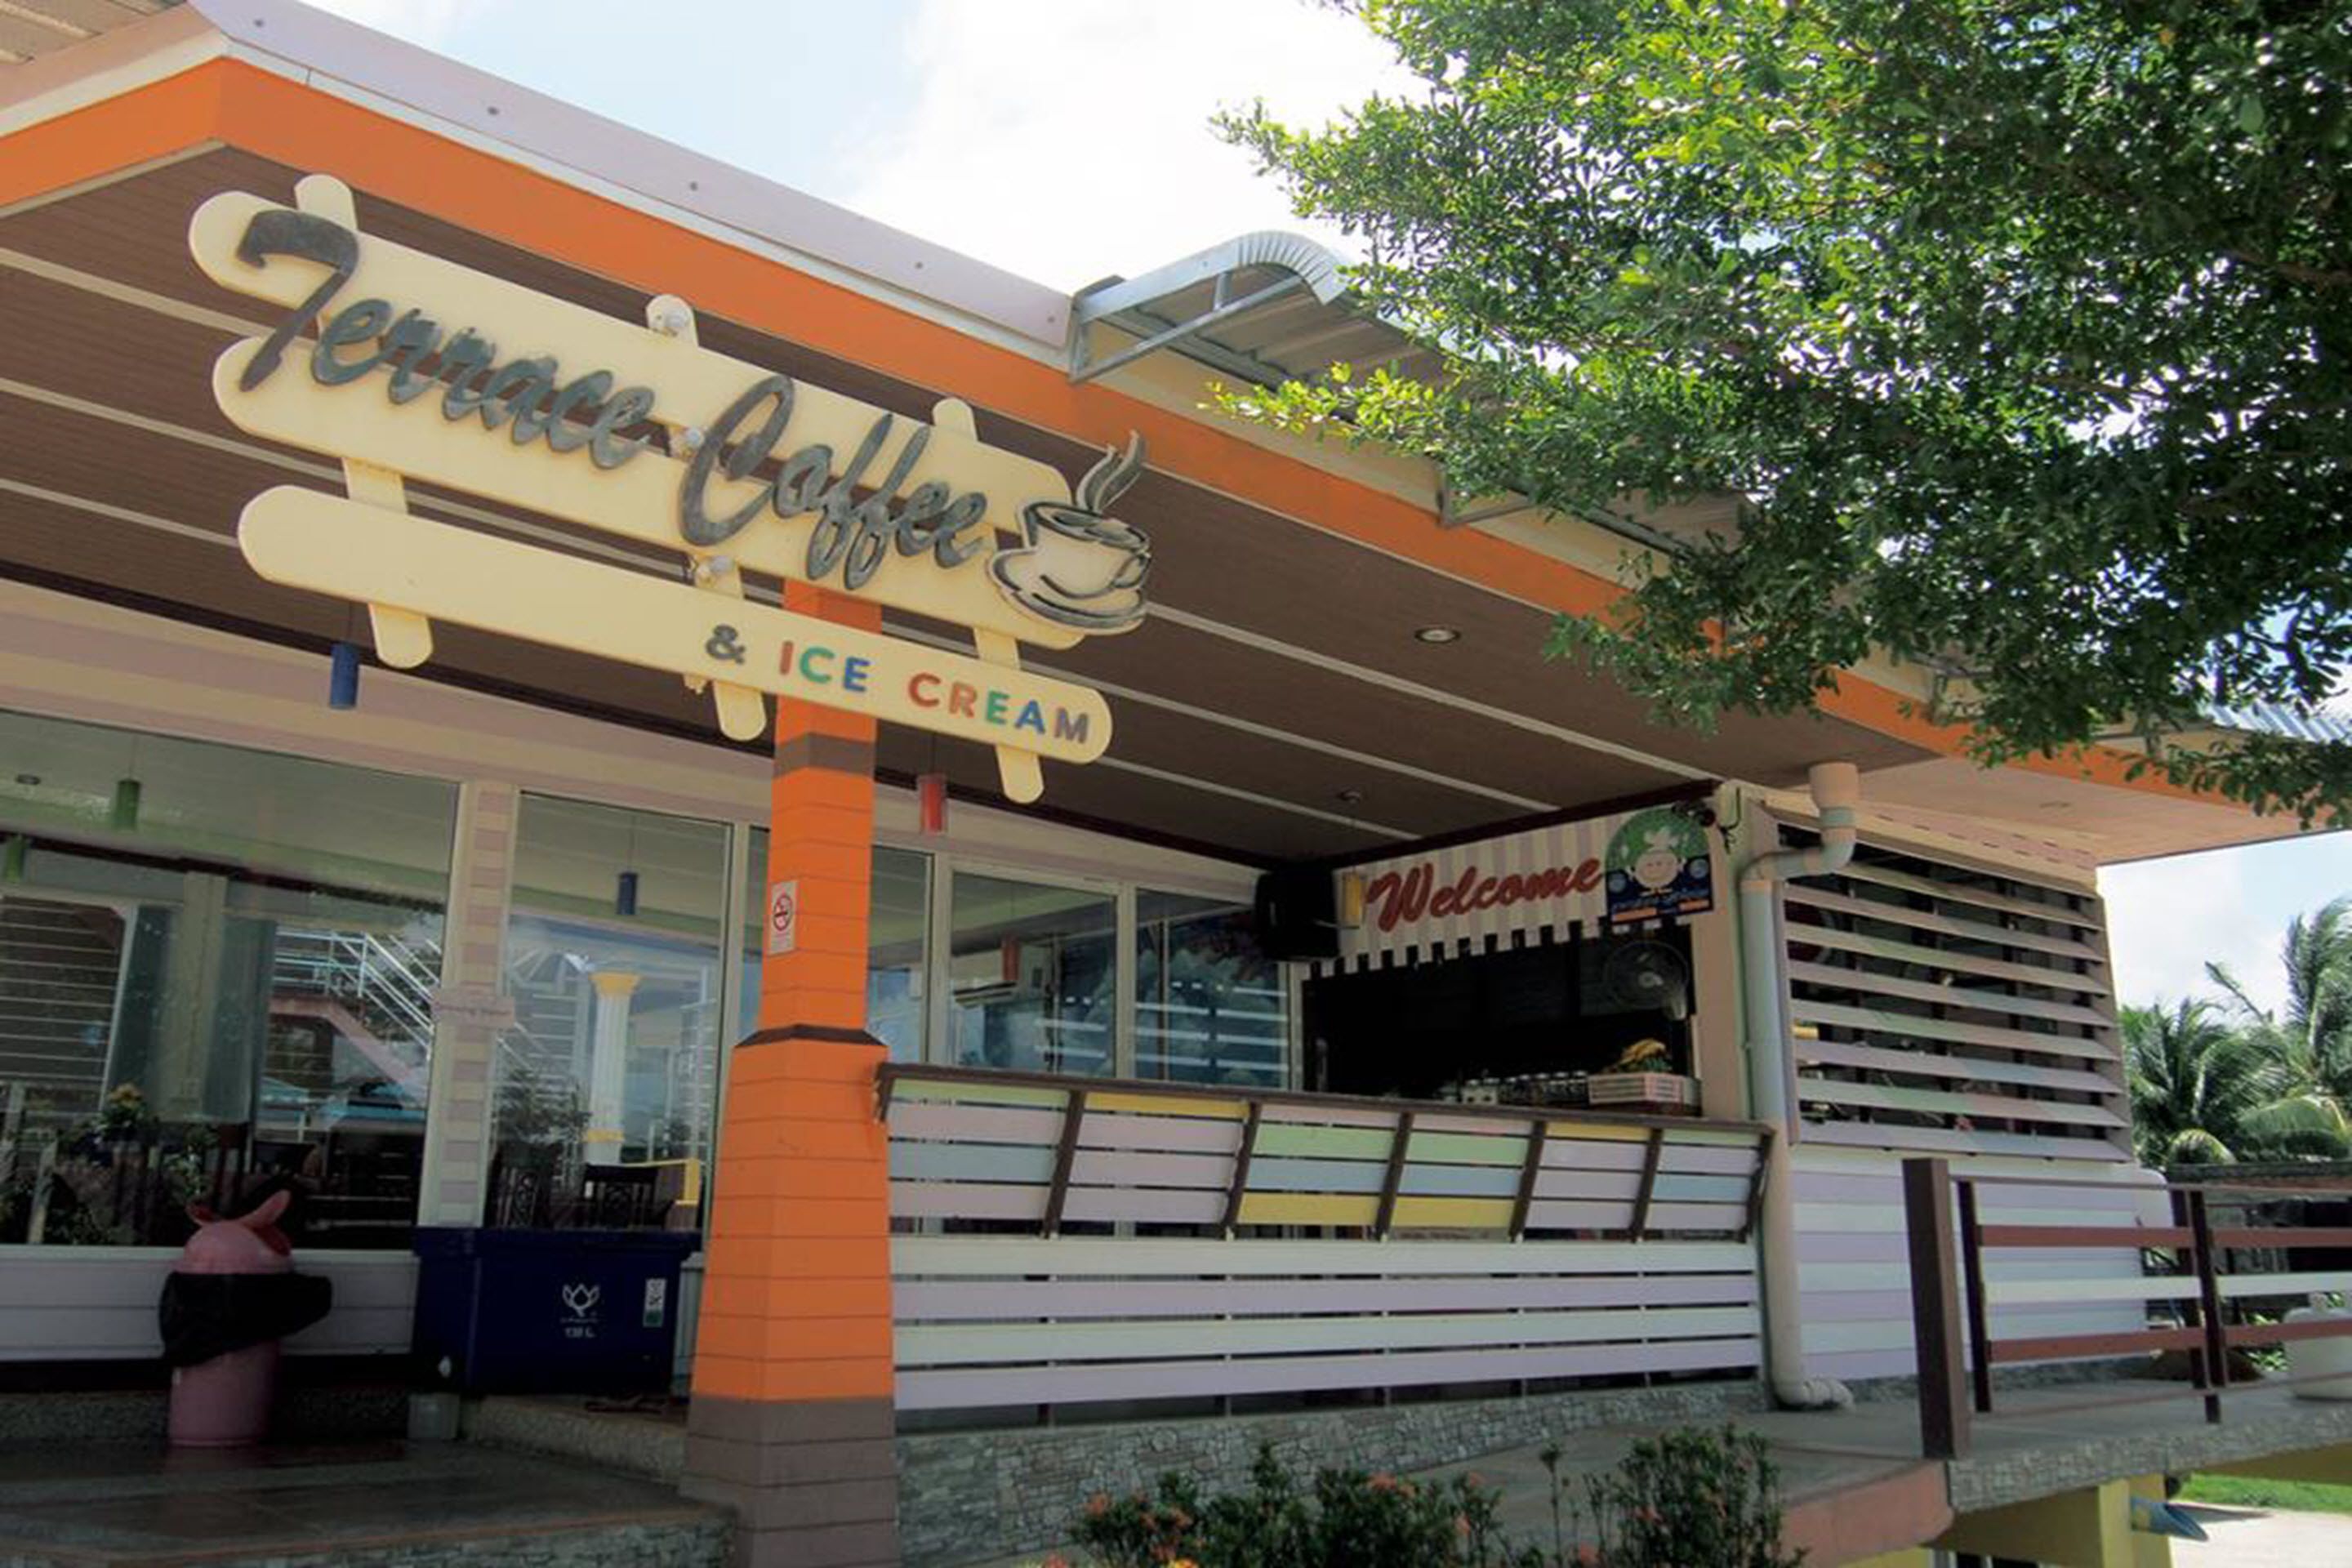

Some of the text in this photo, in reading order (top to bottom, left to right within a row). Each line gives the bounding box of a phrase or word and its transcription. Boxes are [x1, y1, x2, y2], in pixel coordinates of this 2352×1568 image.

[237, 209, 987, 590] Terrace Coffee
[706, 624, 1089, 745] & ICE CREAM
[1366, 858, 1603, 932] Welcome
